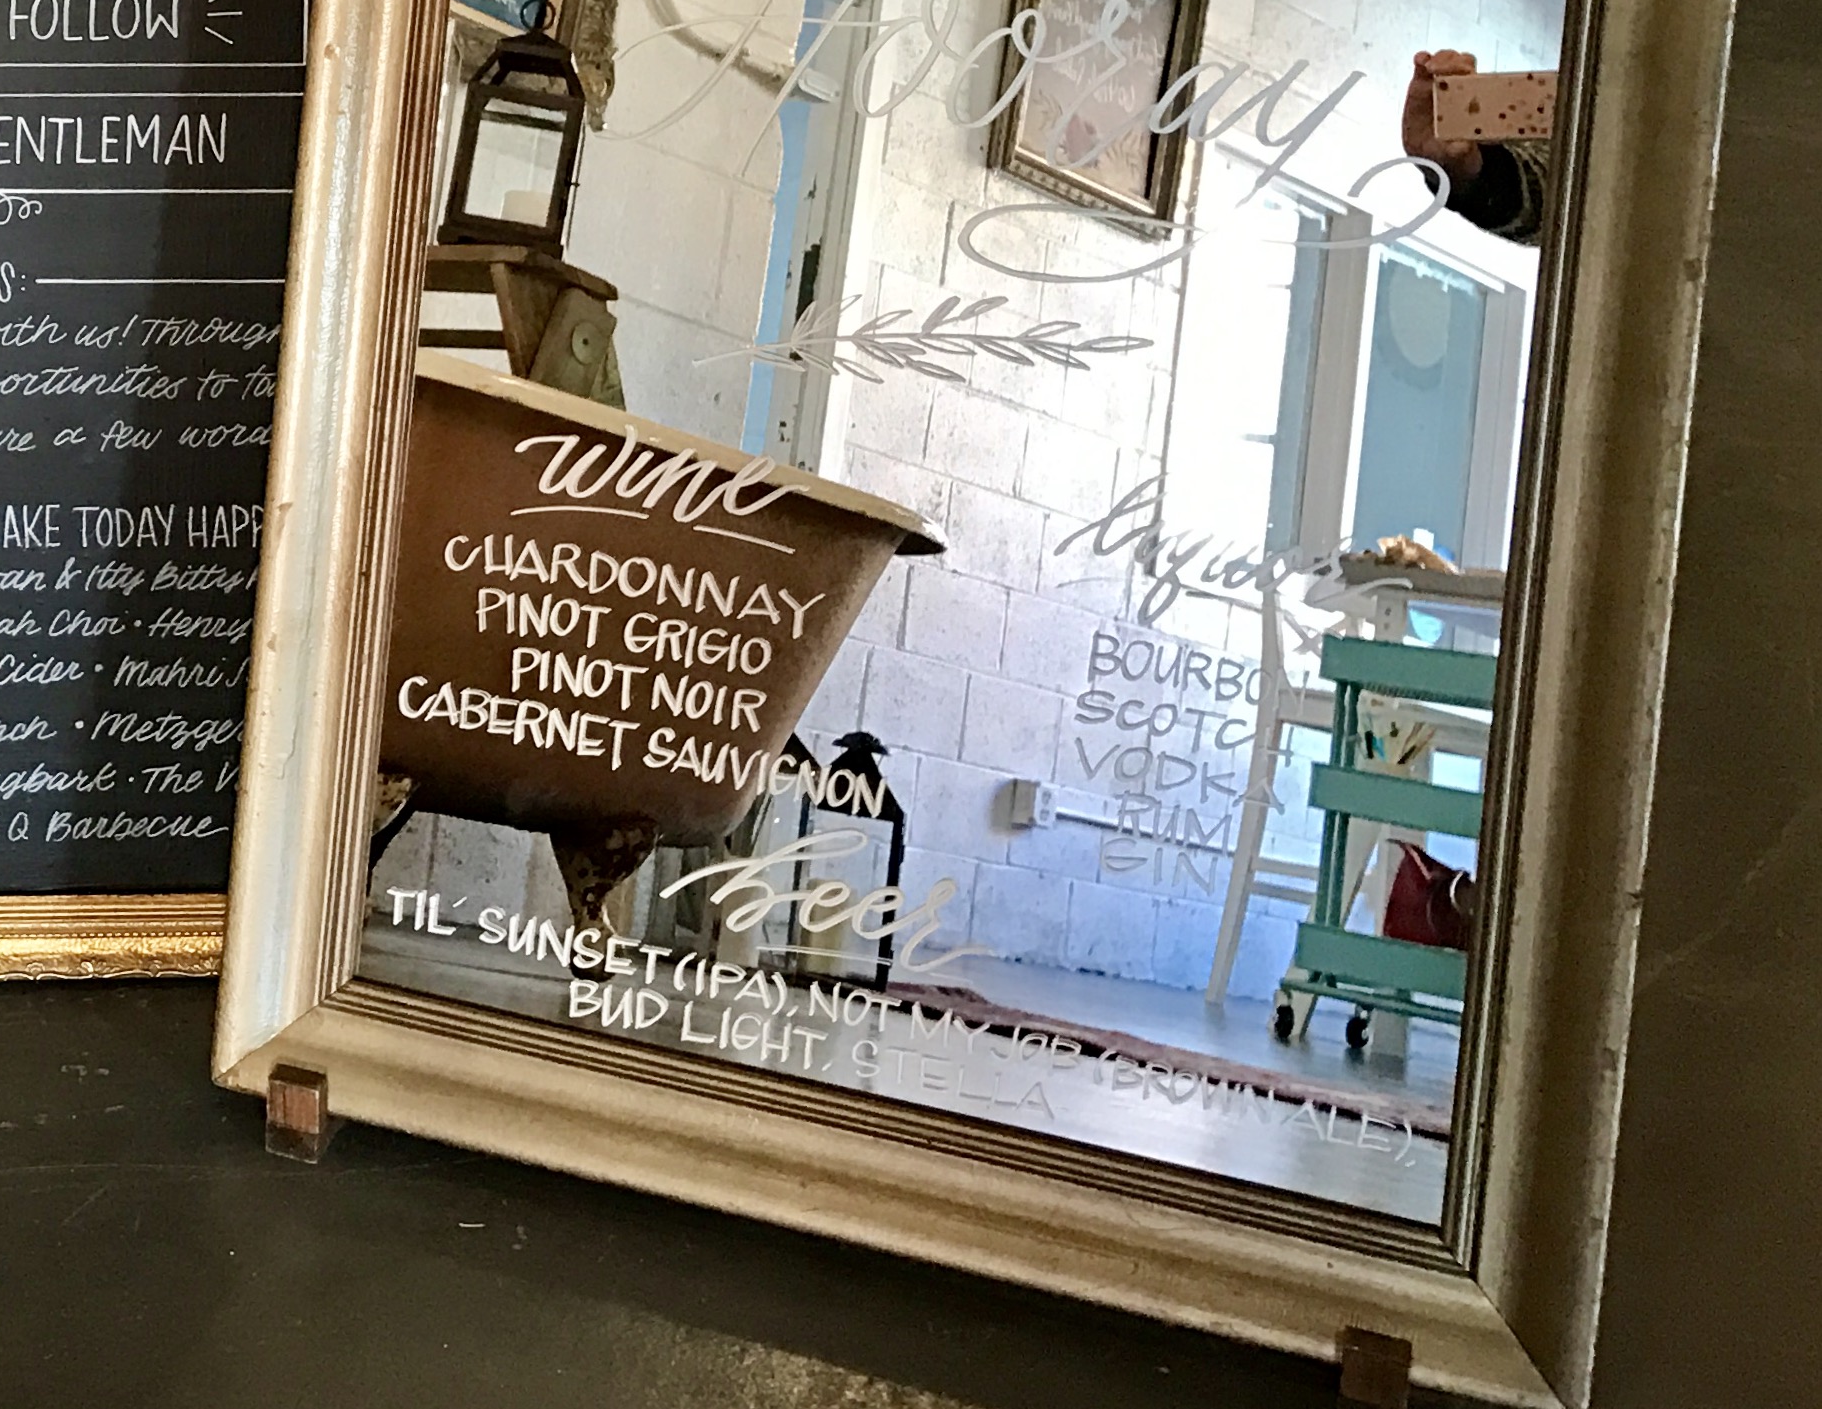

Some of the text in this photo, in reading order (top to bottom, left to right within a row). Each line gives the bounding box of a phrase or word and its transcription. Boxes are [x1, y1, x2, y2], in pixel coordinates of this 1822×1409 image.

[74, 313, 140, 349] us!
[196, 367, 239, 402] to
[52, 425, 85, 447] a
[98, 418, 163, 452] few
[178, 422, 273, 450] word
[514, 423, 812, 524] wine
[72, 502, 177, 550] TODAY
[187, 503, 265, 549] HAPP
[443, 532, 827, 640] CHARDONNAY
[474, 586, 773, 677] PINOT GRIGIO
[510, 646, 768, 734] PINOT NOIR
[1073, 689, 1295, 769] SCOTCH
[398, 674, 890, 818] CABERNET SAUVIGNON
[1074, 736, 1286, 816] VODKA
[1113, 789, 1234, 857] RUM
[658, 827, 996, 973] beer
[1100, 836, 1221, 898] GIN
[477, 903, 674, 986] SUNSET
[808, 980, 902, 1035] NOT
[909, 999, 992, 1050] MY
[989, 1023, 1083, 1072] JOB
[1092, 1048, 1276, 1125] (BROWN
[568, 978, 670, 1031] BUD
[850, 1038, 1057, 1122] STELLA
